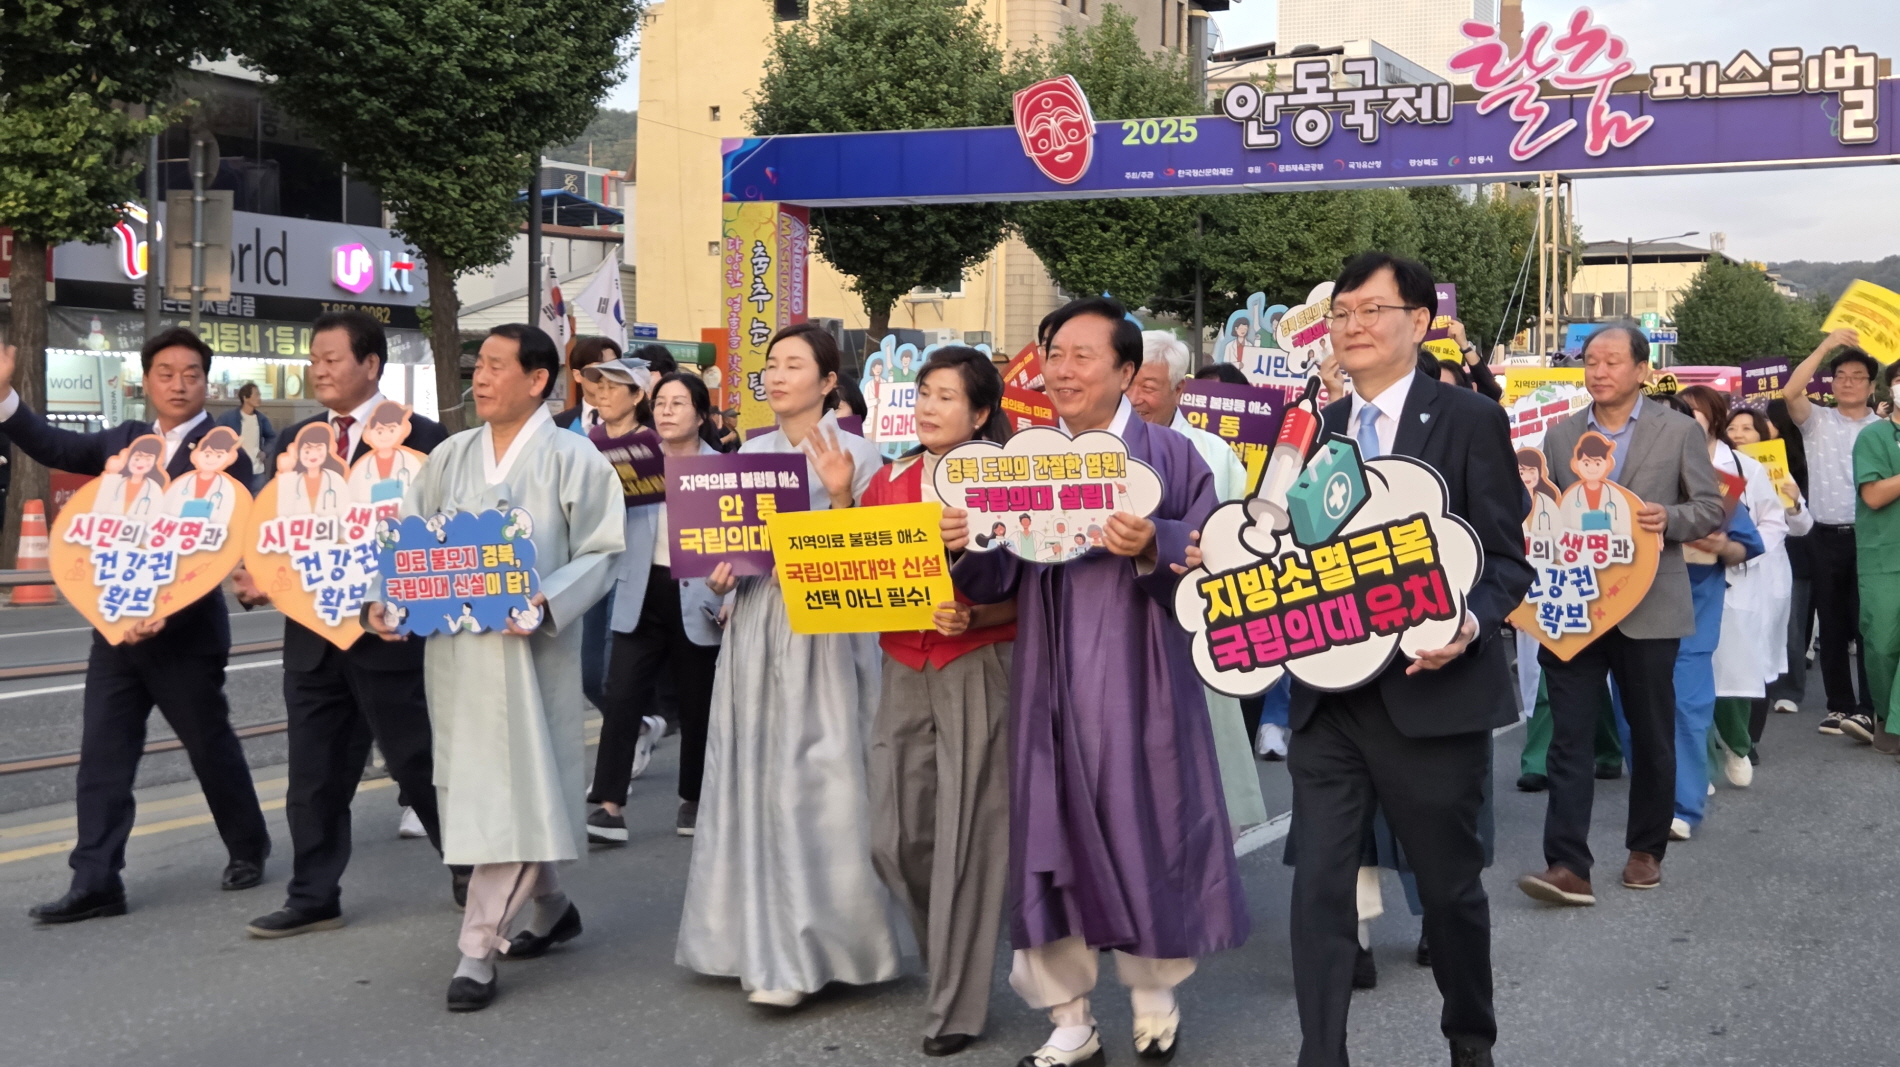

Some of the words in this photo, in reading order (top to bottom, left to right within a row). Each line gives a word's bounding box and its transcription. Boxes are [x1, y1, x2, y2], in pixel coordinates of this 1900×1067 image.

[1223, 56, 1454, 148] 안동국제
[1649, 46, 1878, 143] 페스티벌
[1121, 118, 1198, 146] 2025
[1278, 163, 1324, 173] 문화체육관광부
[1348, 160, 1382, 169] 국가유산청
[1409, 158, 1438, 167] 경상북도
[1468, 155, 1493, 164] 안동시
[231, 228, 288, 287] rld
[380, 250, 415, 293] kt
[725, 236, 744, 288] 다양한
[791, 215, 806, 315] ANDONG
[748, 240, 773, 347] 춤추는
[178, 319, 260, 354] 리동네
[265, 327, 295, 355] 1등
[726, 295, 742, 349] 얼굴을
[1280, 316, 1298, 338] 경북
[1296, 303, 1321, 329] 도민의
[50, 374, 93, 390] world
[1253, 354, 1308, 379] 시민
[1209, 395, 1246, 413] 불평등
[1248, 400, 1272, 415] 해소
[679, 472, 738, 492] 지역의료
[741, 471, 777, 489] 불평등
[778, 471, 800, 489] 해소
[946, 458, 979, 484] 경북
[982, 456, 1030, 482] 도민의
[1033, 453, 1082, 480] 간절한
[1085, 451, 1127, 479] 염원!
[965, 484, 1054, 513] 국립의대
[1058, 483, 1114, 510] 설립!
[69, 516, 141, 548] 시민의
[149, 517, 223, 550] 생명과
[261, 518, 335, 549] 시민의
[679, 524, 771, 555] 국립의대
[787, 533, 845, 551] 지역의료
[848, 531, 893, 548] 불평등
[897, 526, 928, 545] 해소
[1558, 532, 1631, 564] 생명과
[94, 550, 174, 583] 건강권
[395, 549, 428, 574] 의료
[430, 545, 479, 573] 불모지
[481, 543, 522, 569] 경북,
[785, 557, 897, 584] 국립의과대학
[902, 554, 943, 579] 신설
[1201, 518, 1435, 623] 지방소멸극복
[104, 584, 153, 617] 확보
[386, 575, 451, 601] 국립의대
[452, 572, 502, 598] 신설이
[804, 591, 842, 611] 선택
[846, 588, 882, 610] 아닌
[886, 586, 932, 608] 필수!
[1209, 592, 1366, 669] 국립의대
[1365, 568, 1451, 633] 유치
[1539, 601, 1587, 634] 확보
